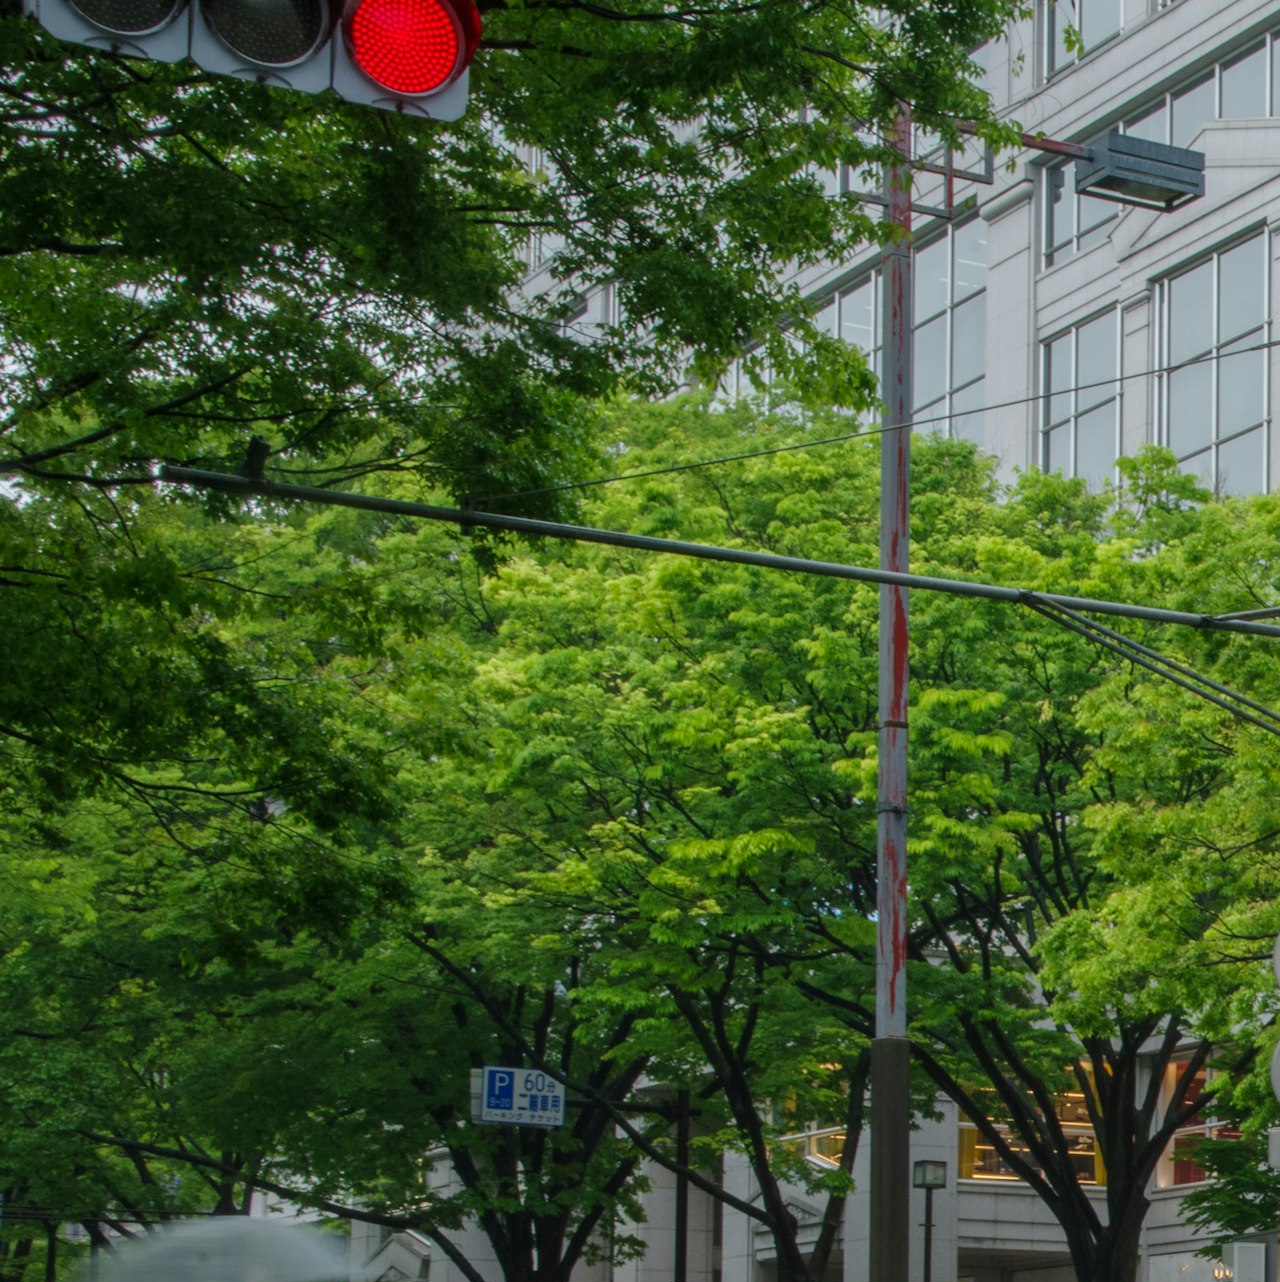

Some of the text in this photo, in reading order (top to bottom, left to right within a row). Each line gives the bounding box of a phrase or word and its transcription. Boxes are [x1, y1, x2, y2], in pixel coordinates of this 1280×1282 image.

[494, 1073, 509, 1095] P
[518, 1093, 560, 1113] 二輪車用
